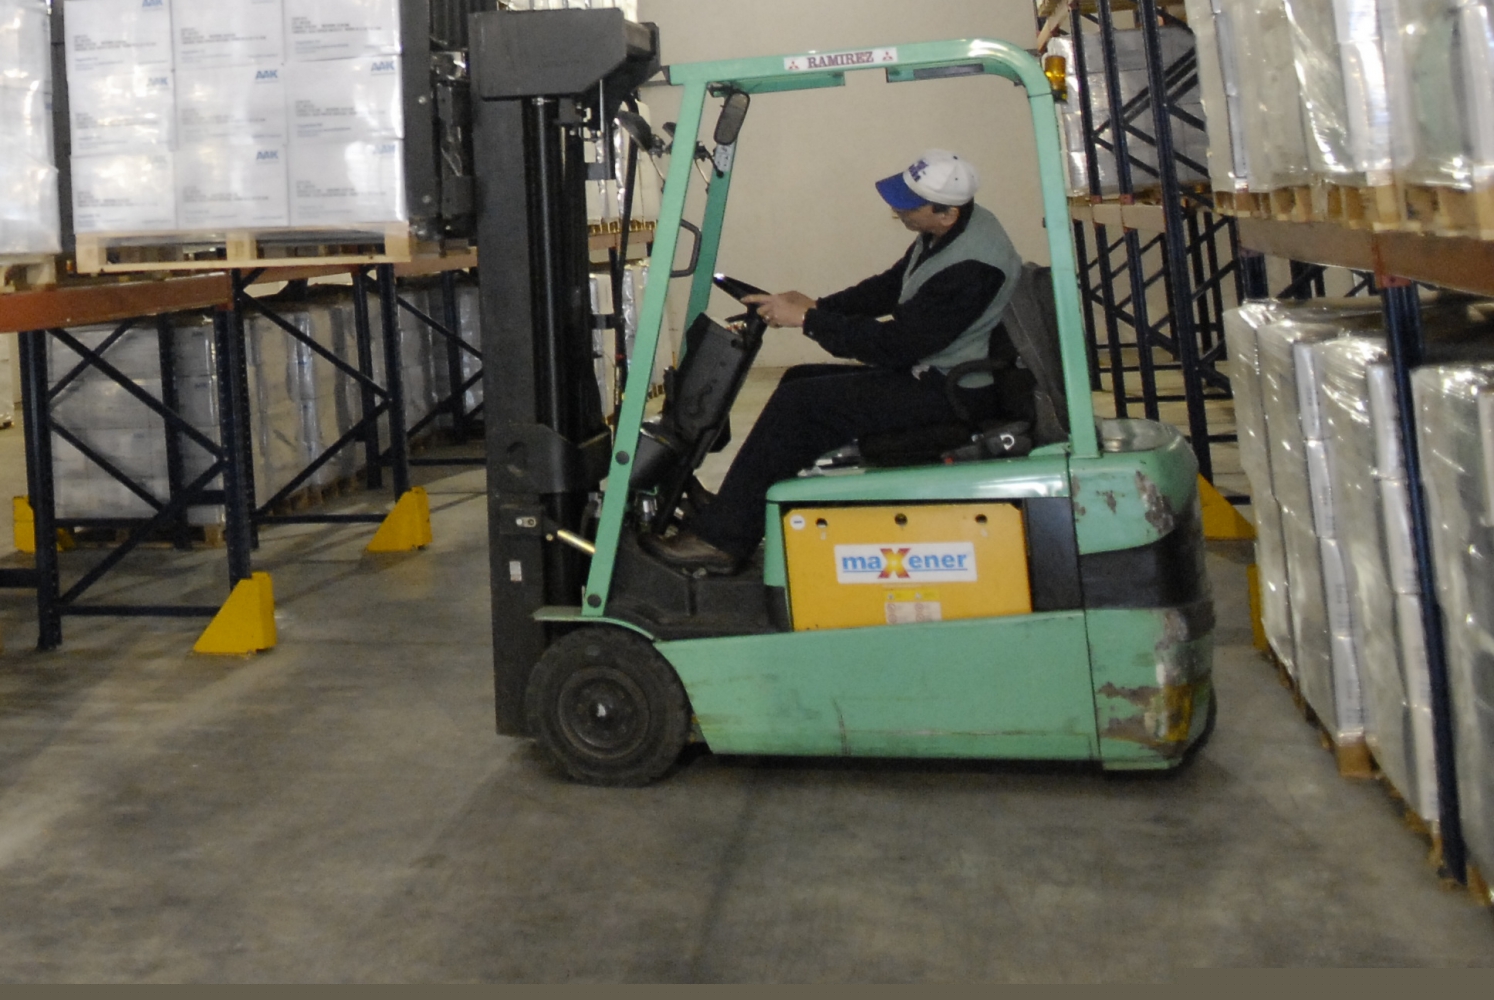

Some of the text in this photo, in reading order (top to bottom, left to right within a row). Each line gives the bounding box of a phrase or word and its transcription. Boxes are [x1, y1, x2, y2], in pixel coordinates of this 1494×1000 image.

[807, 51, 875, 69] RAMIREZ
[370, 60, 395, 73] AAK
[255, 69, 278, 81] AAK
[256, 149, 279, 161] AAK
